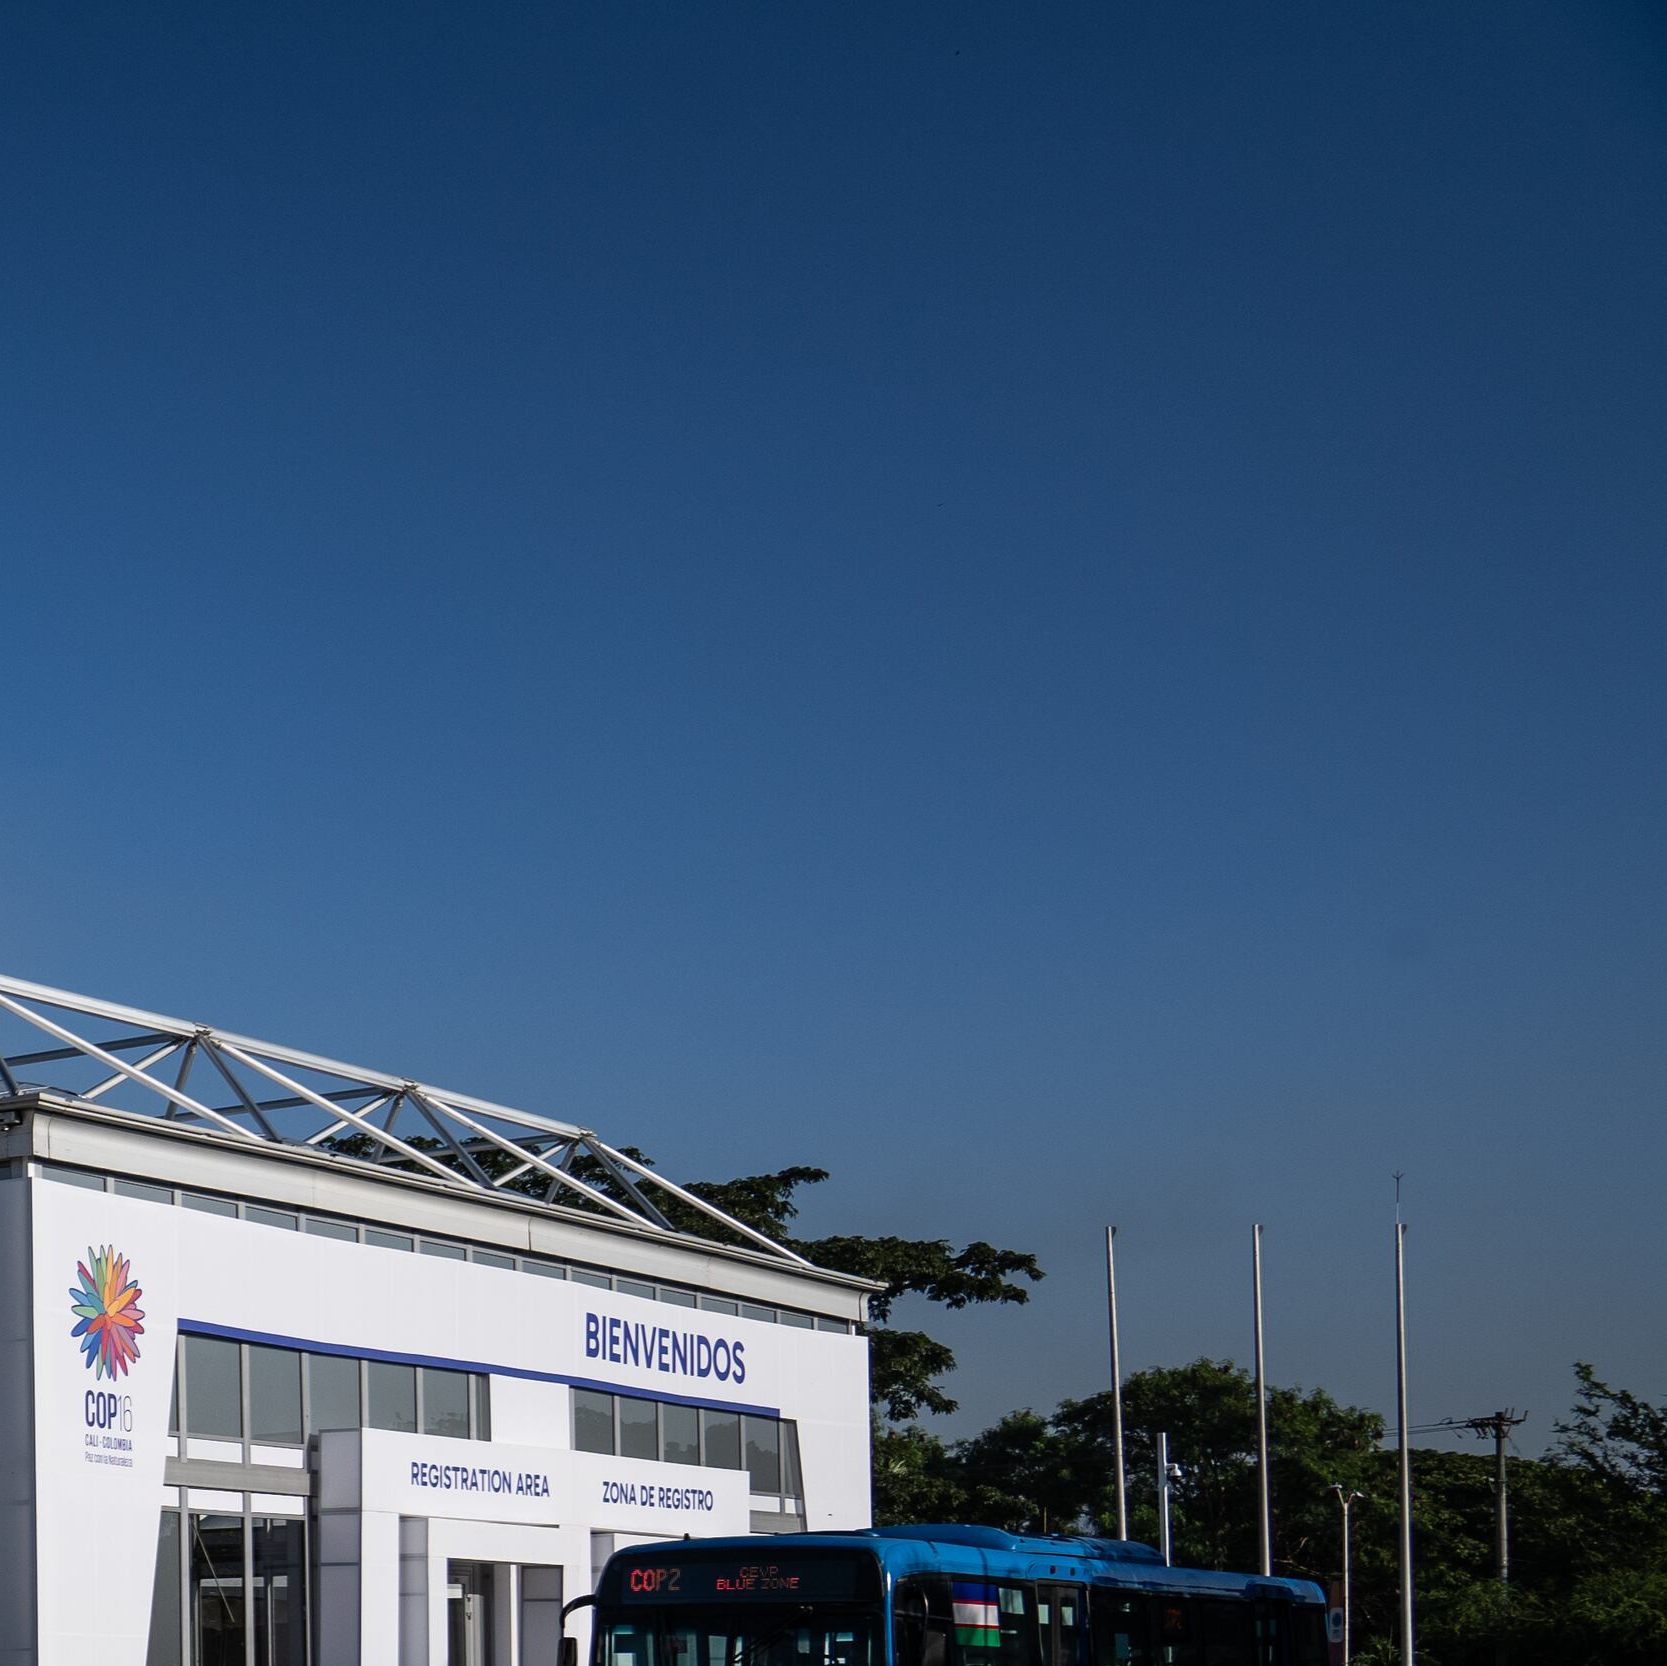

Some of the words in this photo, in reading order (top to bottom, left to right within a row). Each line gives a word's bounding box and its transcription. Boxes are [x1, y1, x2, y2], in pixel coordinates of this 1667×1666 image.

[585, 1312, 746, 1385] BIENVENIDOS
[85, 1390, 132, 1432] COP16
[85, 1434, 98, 1447] CALI
[102, 1436, 132, 1451] COLOMBIA
[411, 1461, 512, 1495] REGISTRATION
[516, 1473, 550, 1498] AREA
[602, 1481, 637, 1506] ZONA
[640, 1484, 655, 1508] DE
[658, 1486, 714, 1512] REGISTRO
[716, 1578, 755, 1591] BLUE
[760, 1577, 800, 1590] ZONE
